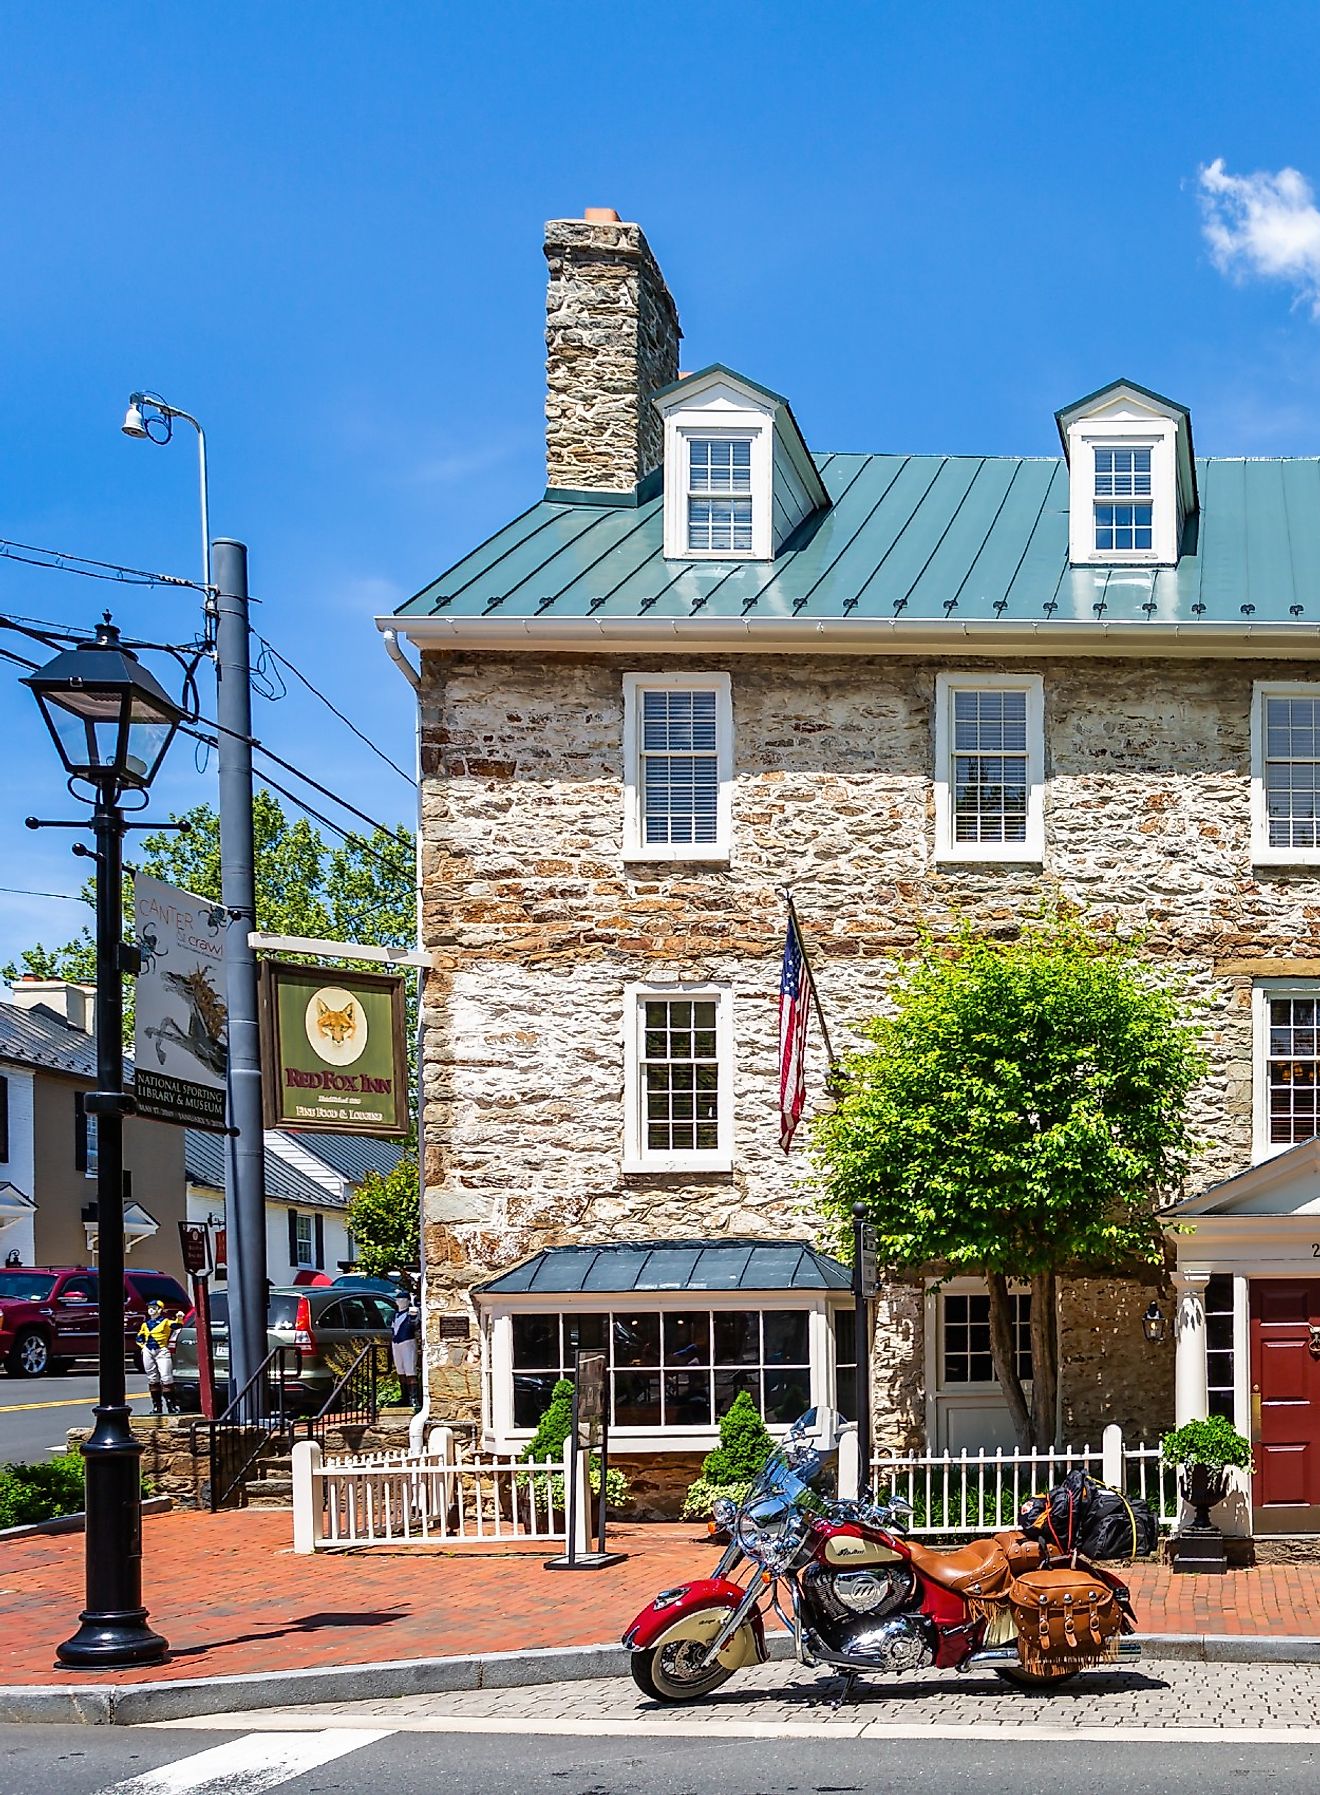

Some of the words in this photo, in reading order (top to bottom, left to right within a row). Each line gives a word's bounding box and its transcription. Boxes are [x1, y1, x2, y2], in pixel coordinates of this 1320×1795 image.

[139, 898, 194, 930] CANTER
[188, 936, 223, 956] crawl
[137, 1073, 181, 1093] NATIONAL
[182, 1084, 223, 1103] SPORTING
[285, 1067, 320, 1088] RED
[320, 1070, 360, 1091] FOX
[359, 1073, 392, 1094] INN
[137, 1085, 175, 1103] LIBRARY
[176, 1094, 184, 1106] &
[185, 1097, 223, 1115] MUSEUM
[316, 1106, 338, 1118] FOOD
[339, 1108, 348, 1119] &
